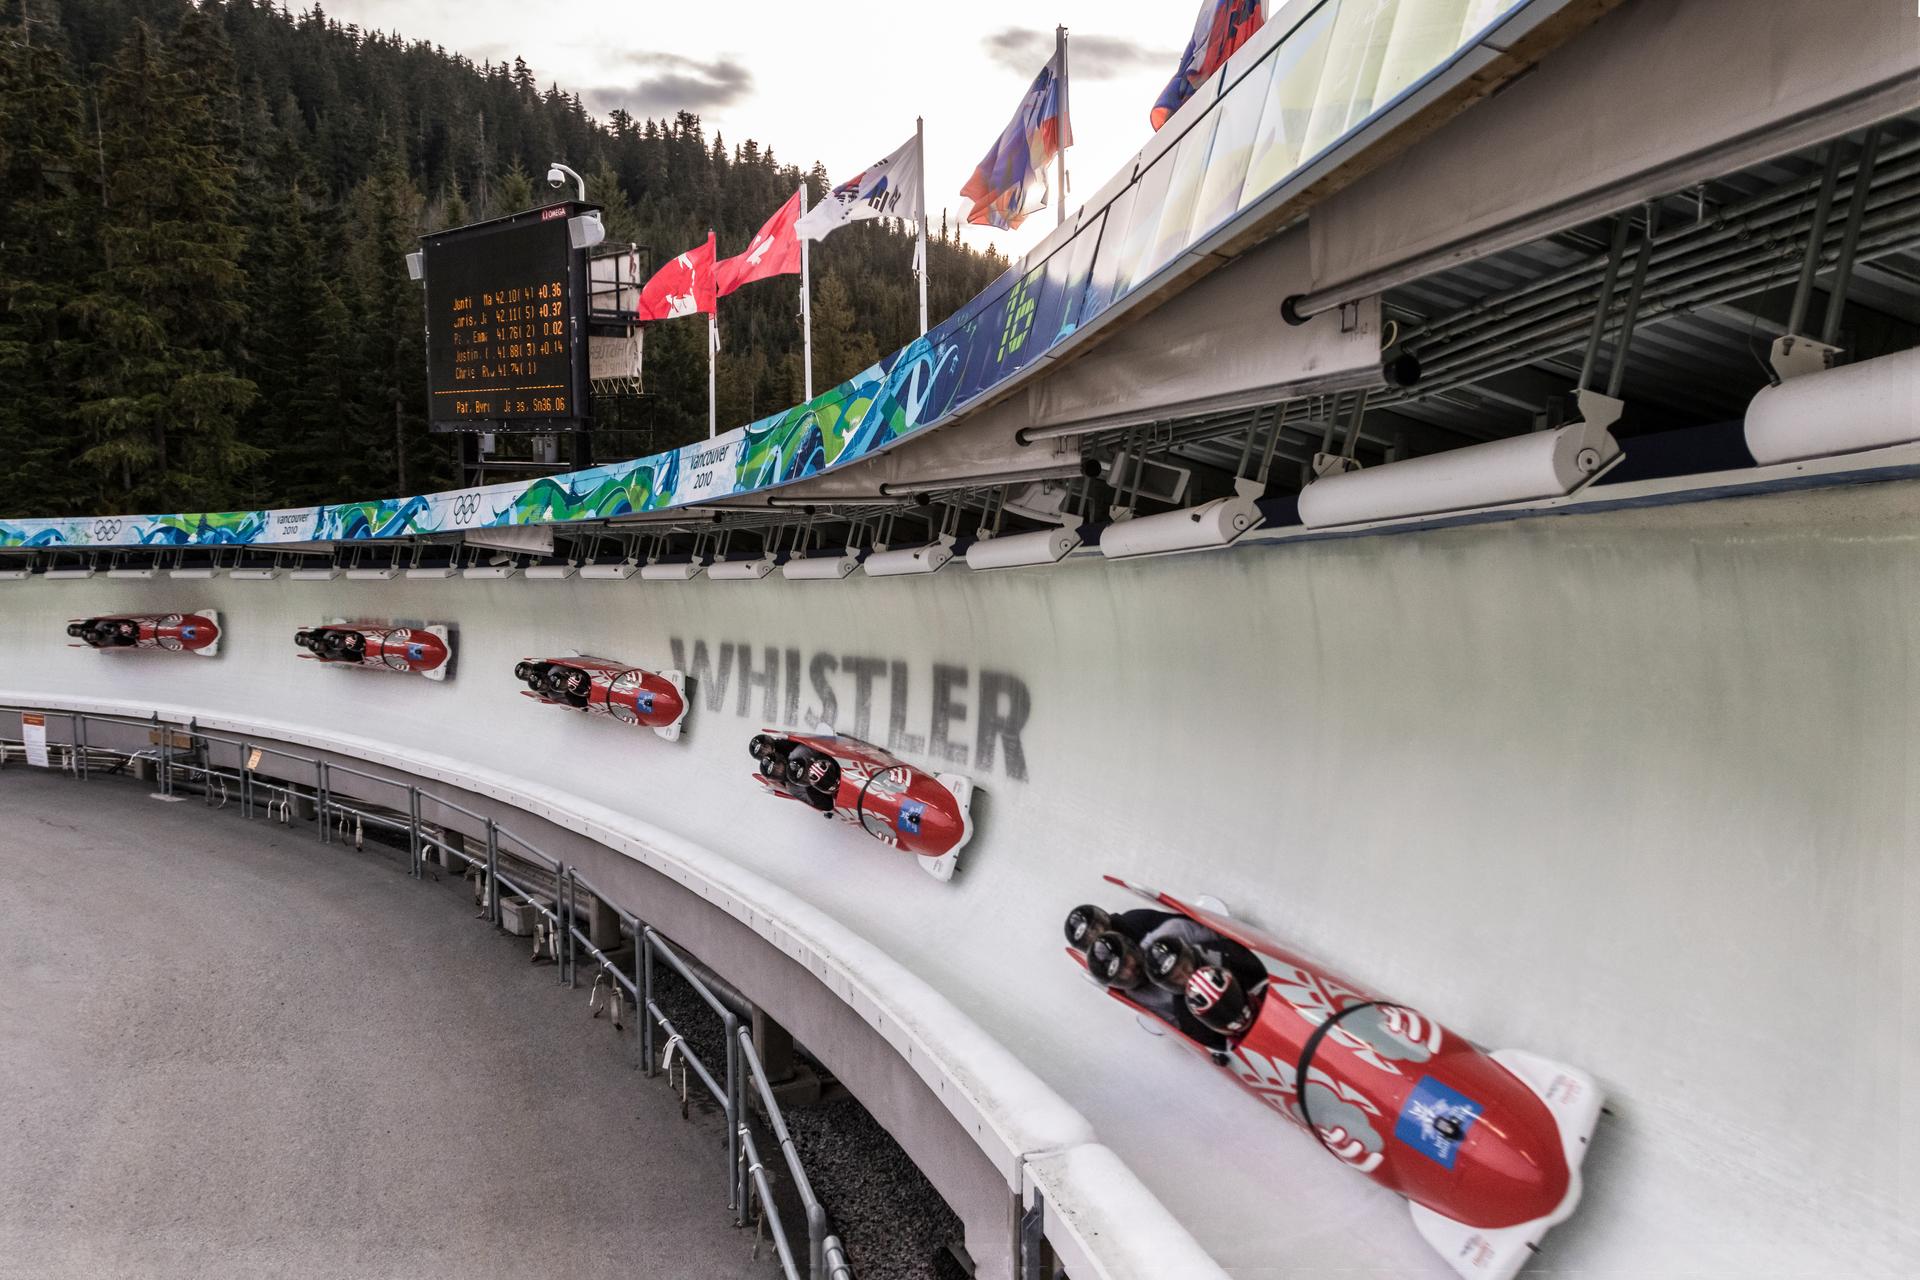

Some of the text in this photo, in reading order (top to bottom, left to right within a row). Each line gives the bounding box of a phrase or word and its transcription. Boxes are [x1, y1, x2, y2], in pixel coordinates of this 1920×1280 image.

[549, 207, 567, 218] OMEGA
[538, 282, 562, 299] +0.36
[539, 301, 562, 318] +0.37
[693, 470, 713, 489] 2010
[282, 526, 299, 535] 2010
[669, 636, 1031, 783] WHISTLER
